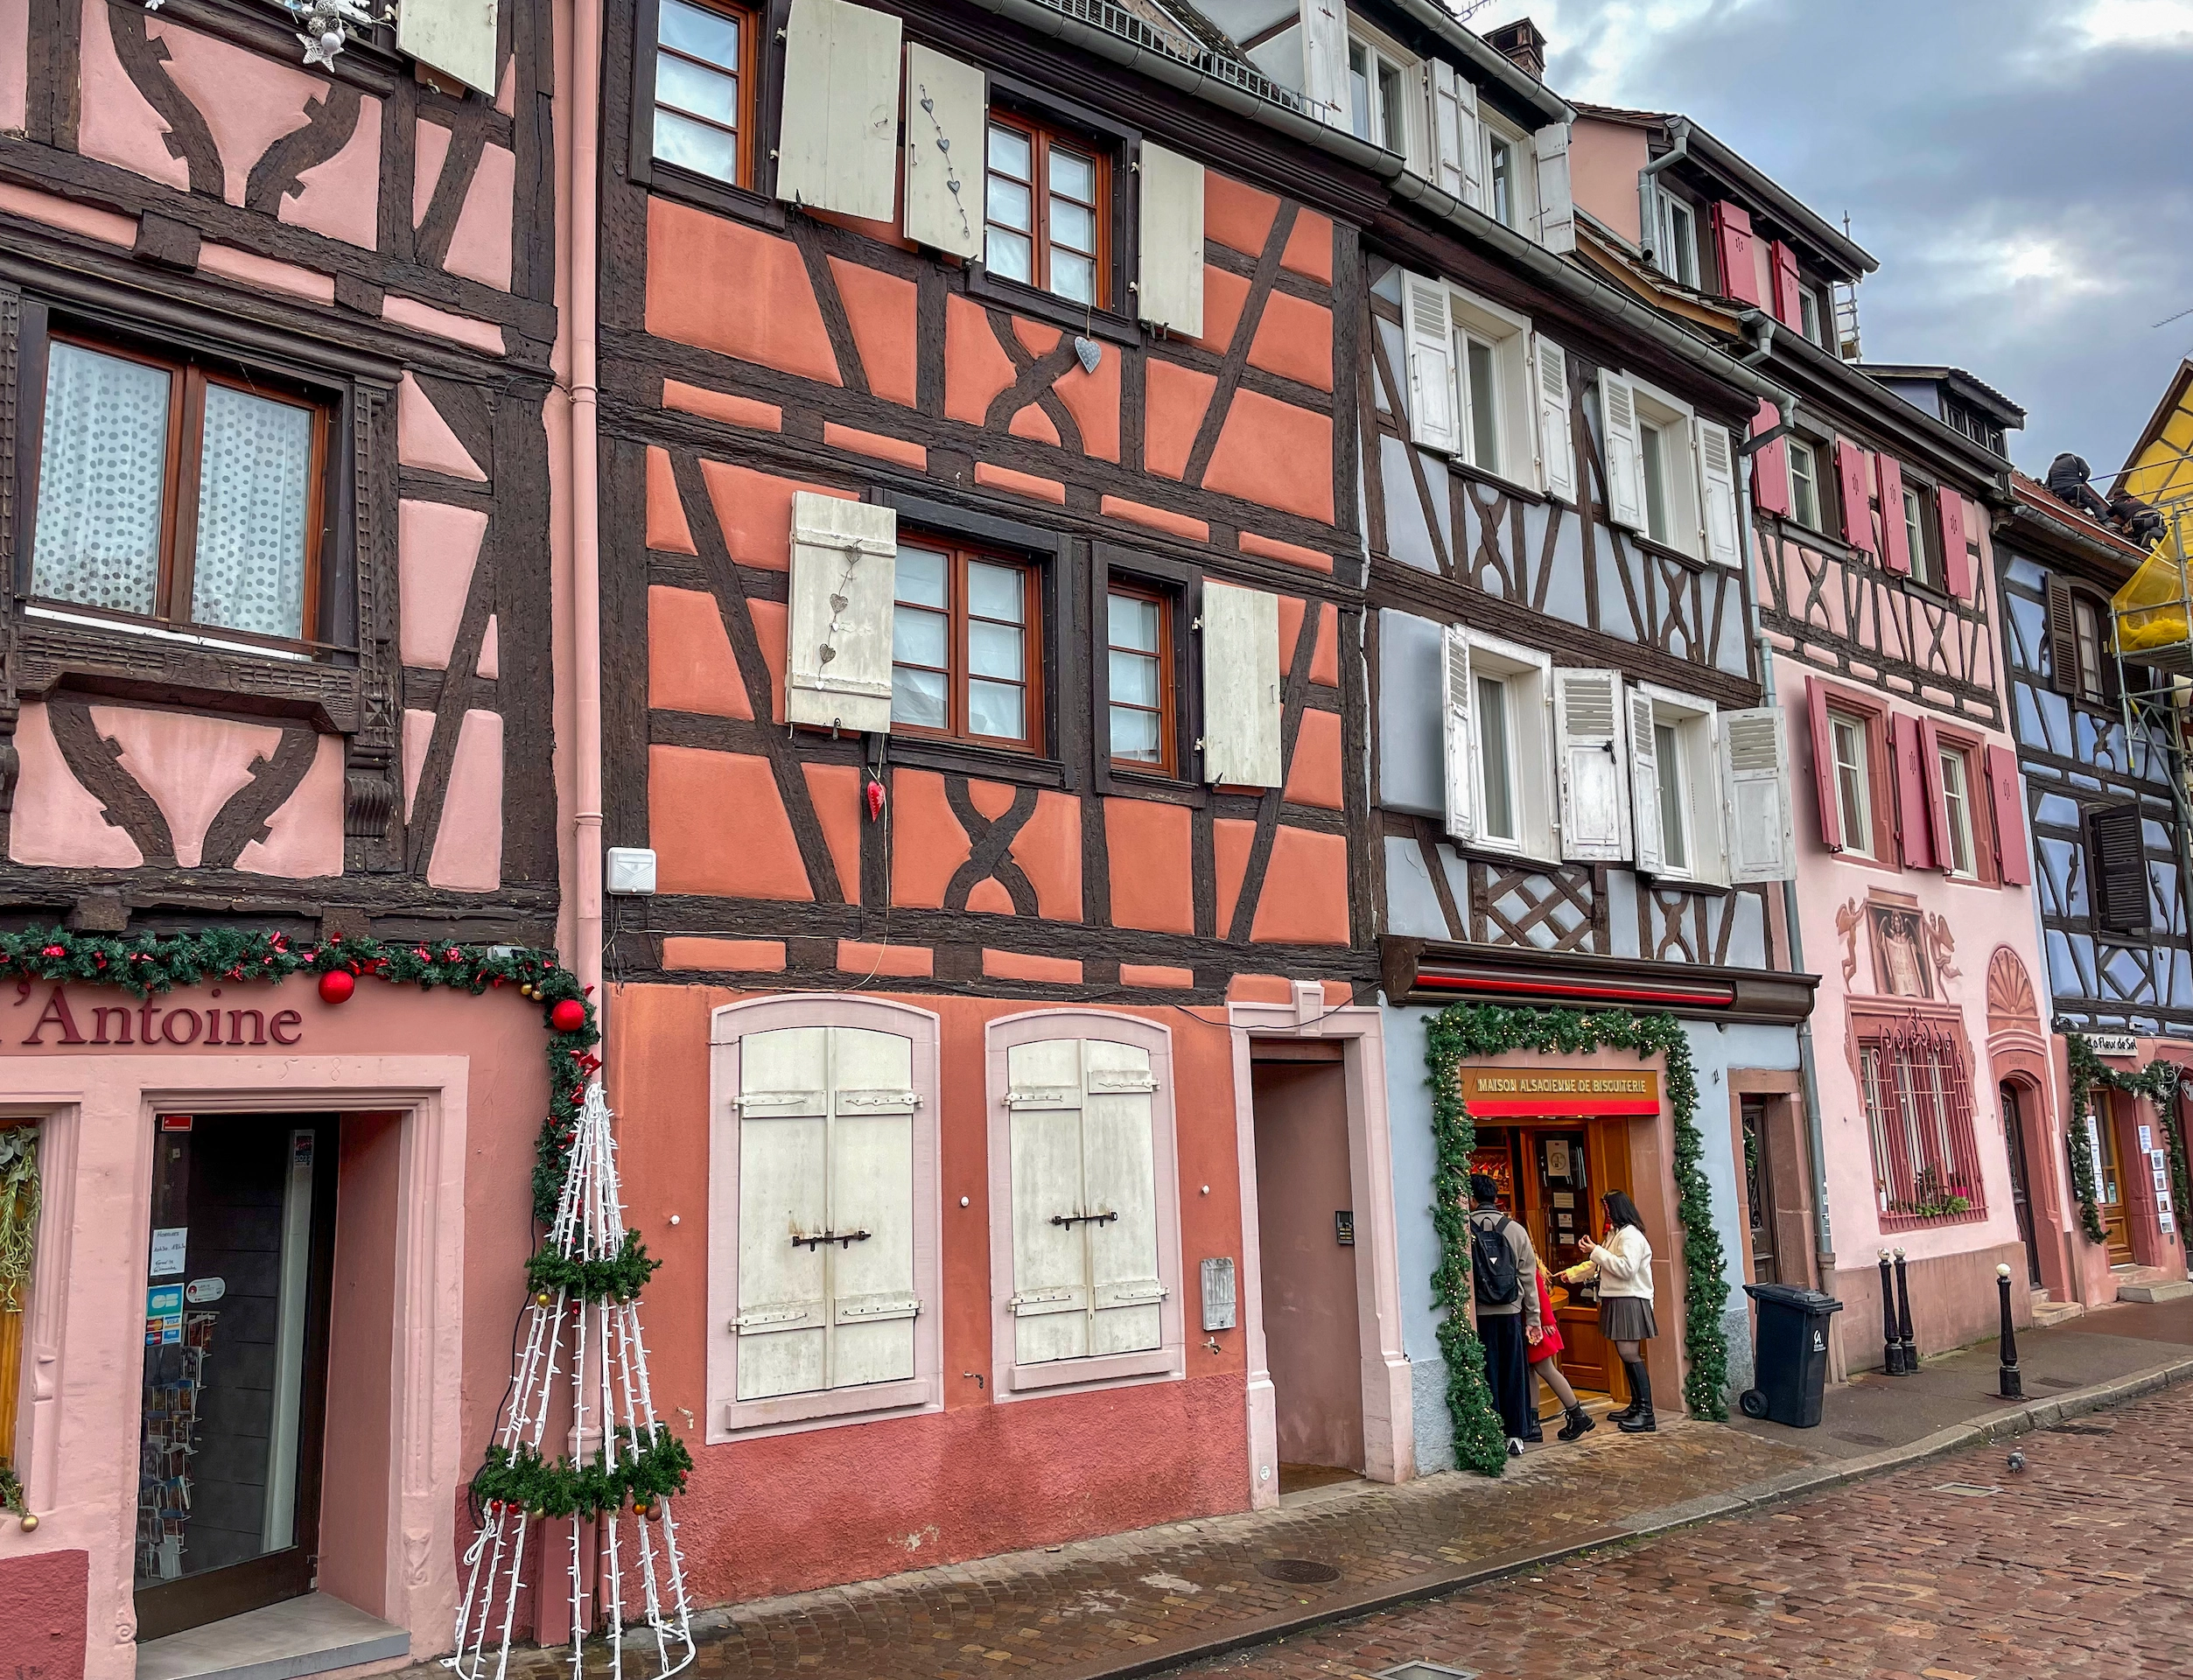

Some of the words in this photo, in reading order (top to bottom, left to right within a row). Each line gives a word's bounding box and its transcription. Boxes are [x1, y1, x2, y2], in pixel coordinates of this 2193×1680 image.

[0, 982, 303, 1045] 'Antoine
[2098, 1036, 2116, 1049] Fleur
[2118, 1037, 2125, 1049] de
[2126, 1037, 2138, 1050] Sel
[1478, 1078, 1517, 1093] MAISON
[1519, 1078, 1576, 1093] ALSACIENNE
[1578, 1079, 1591, 1093] DE
[1592, 1079, 1647, 1093] BISCUITERIE
